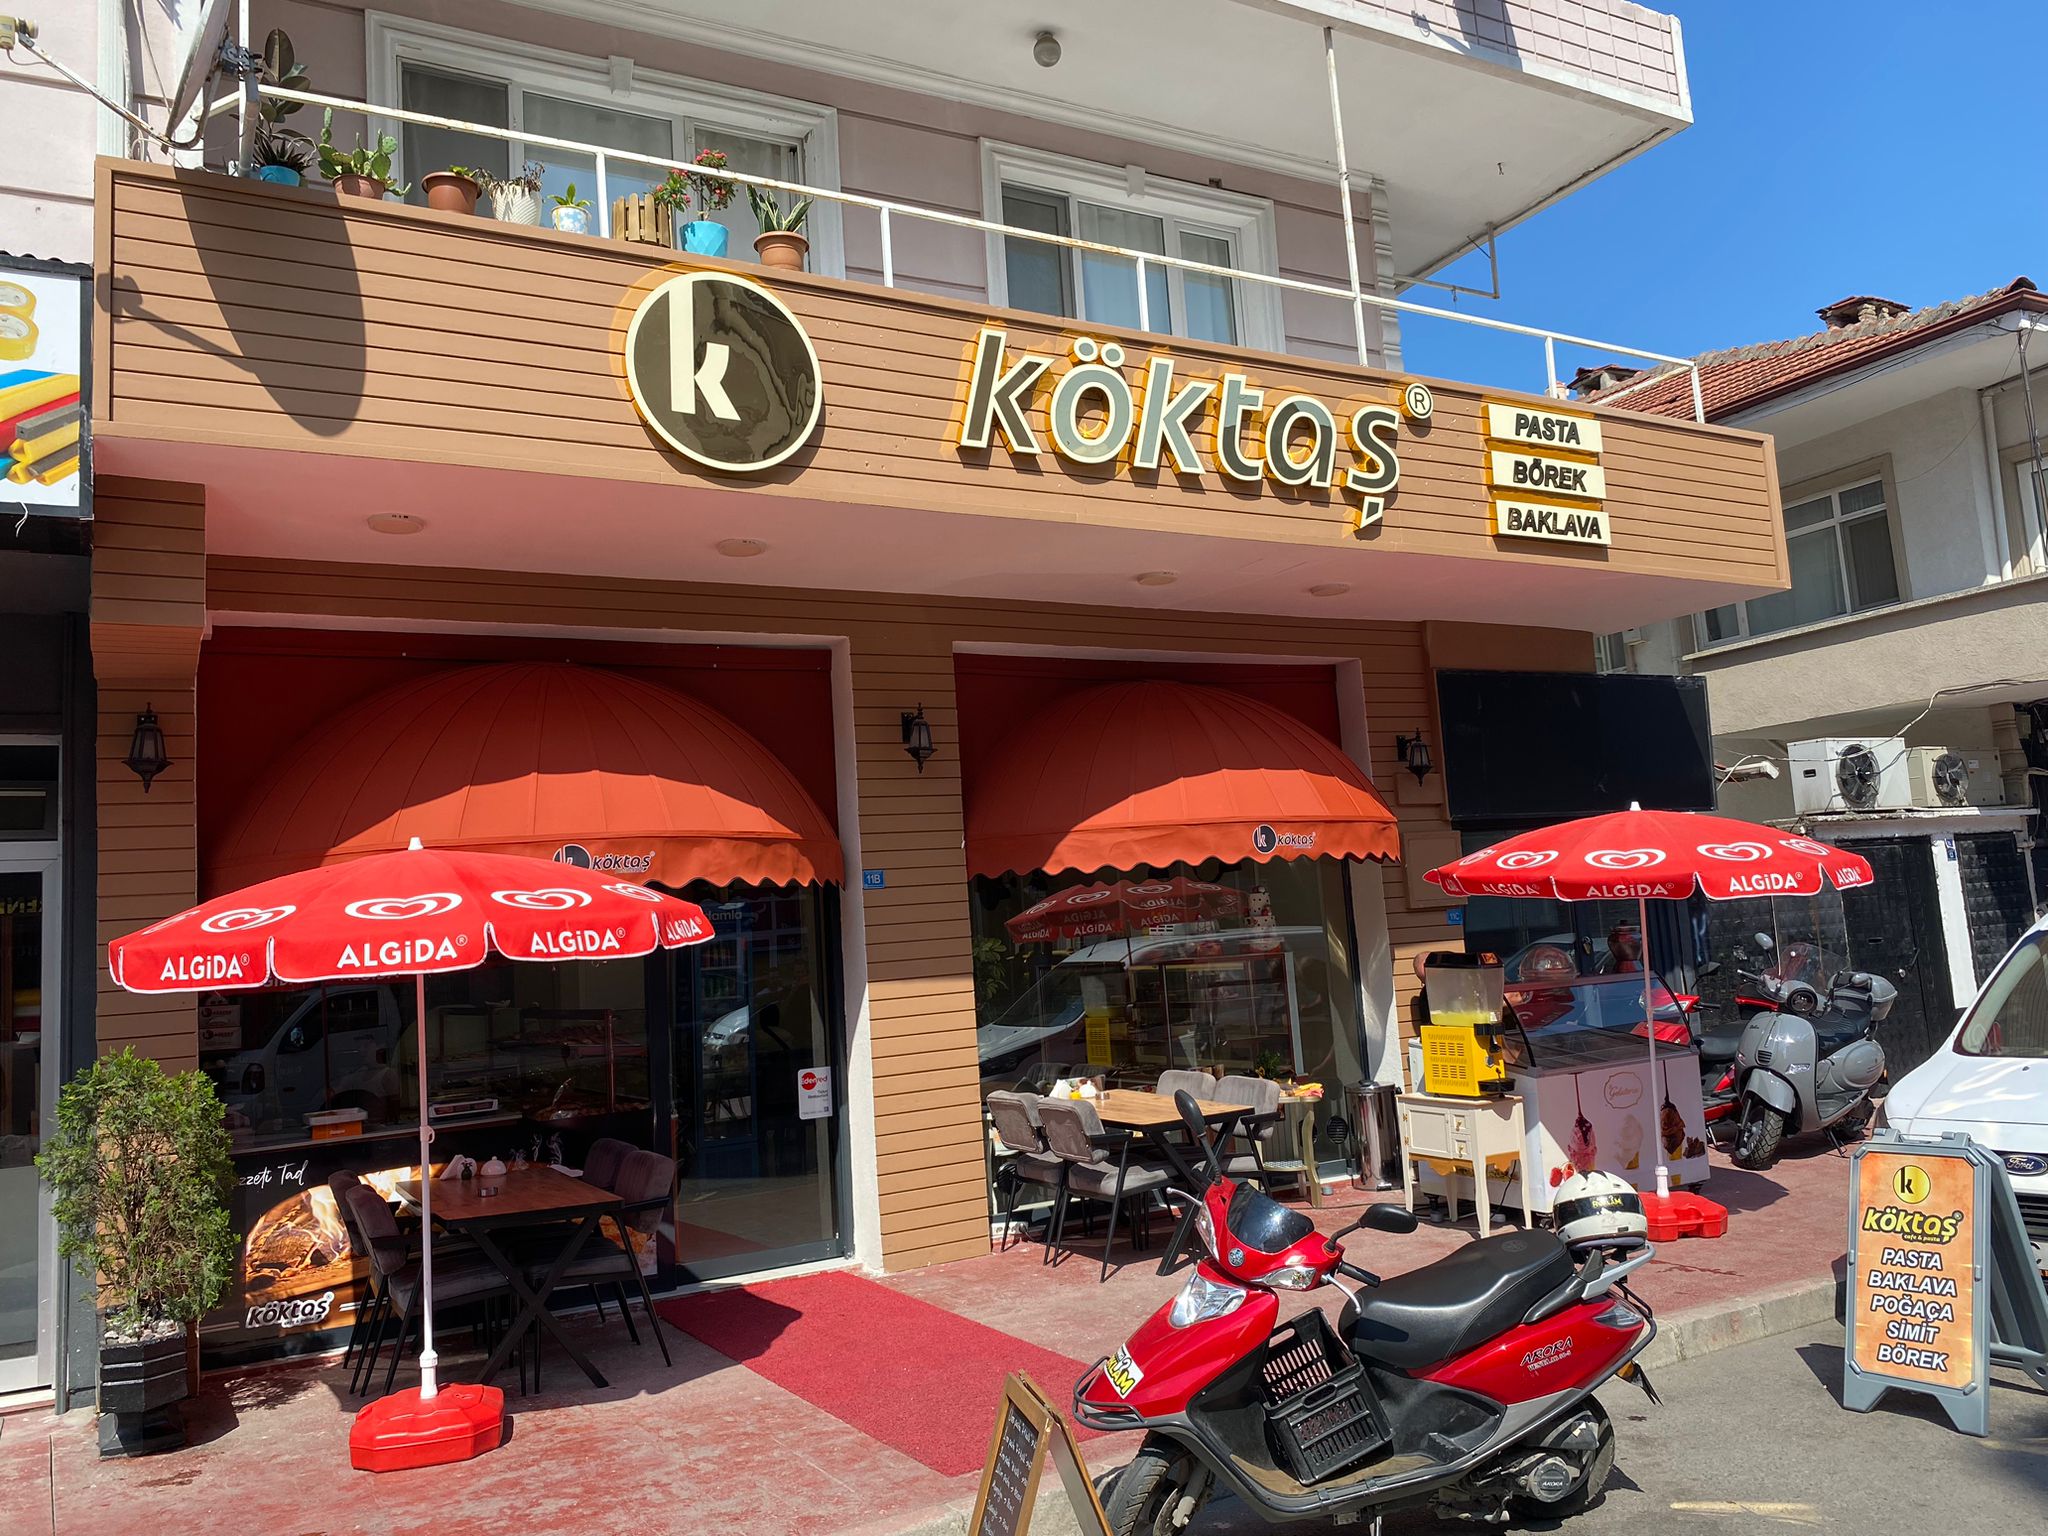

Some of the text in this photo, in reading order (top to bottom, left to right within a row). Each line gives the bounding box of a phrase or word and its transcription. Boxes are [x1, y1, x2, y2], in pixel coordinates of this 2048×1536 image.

[1514, 413, 1581, 445] PASTA
[1512, 457, 1588, 493] BÖREK
[1507, 507, 1603, 540] BAKLAVA
[864, 873, 881, 885] 11B
[277, 1159, 309, 1187] Tad
[2006, 1156, 2035, 1171] Ford
[1881, 1248, 1943, 1270] PASTA
[1868, 1271, 1957, 1297] BAKLAVA
[1871, 1294, 1954, 1321] POĞAÇA
[1886, 1319, 1939, 1344] SİMİT
[1519, 1335, 1574, 1367] ARORA
[1877, 1343, 1948, 1371] BÖREK
